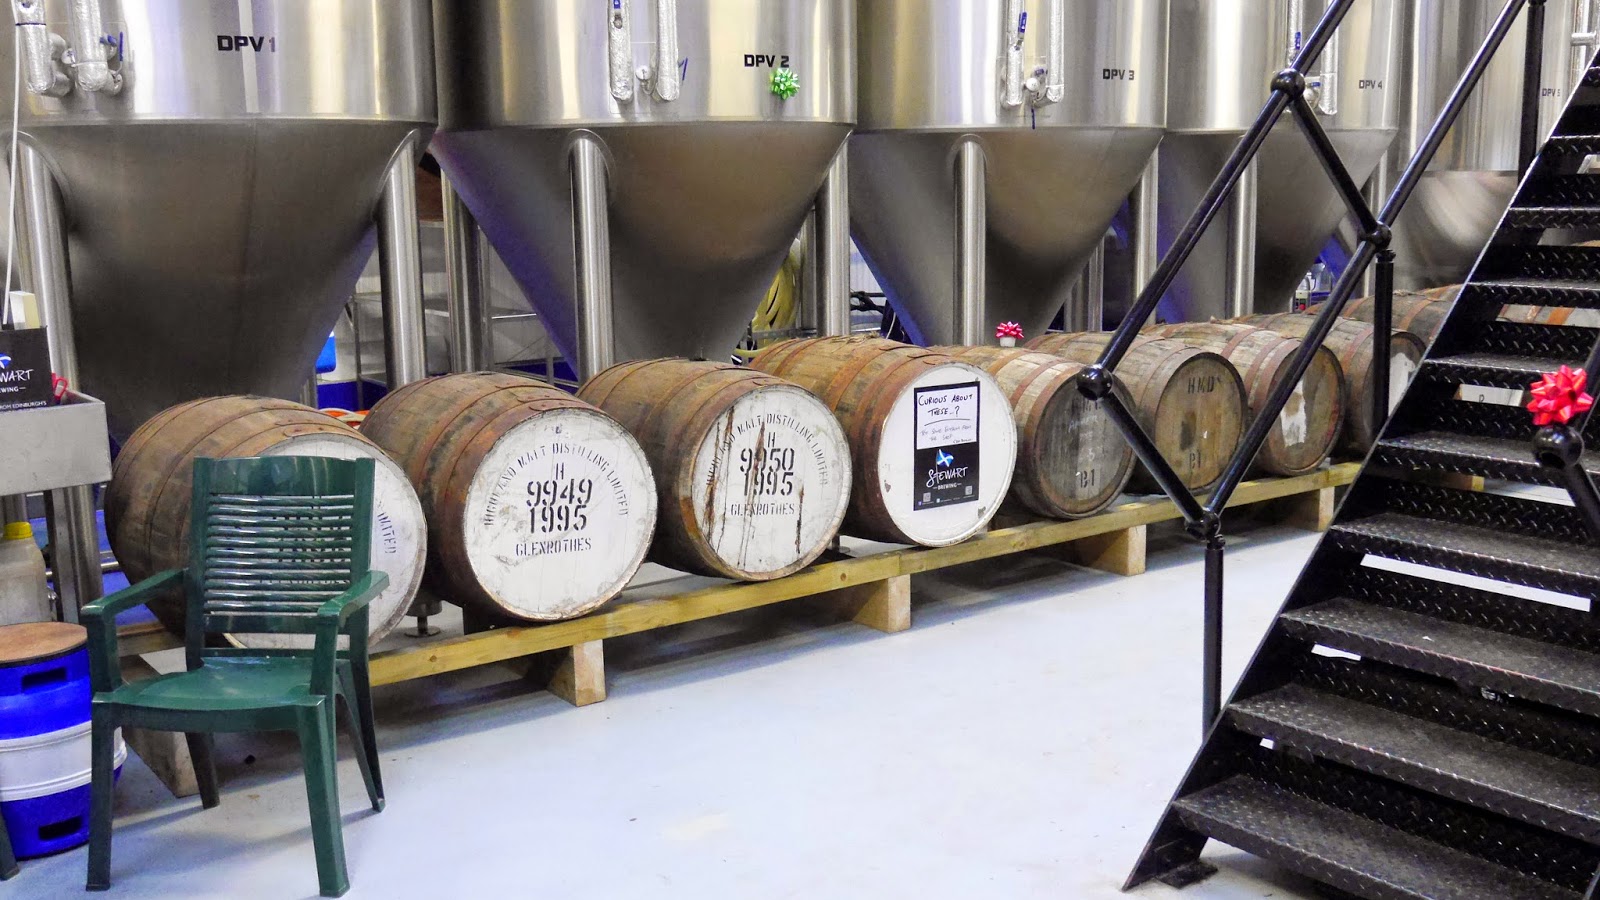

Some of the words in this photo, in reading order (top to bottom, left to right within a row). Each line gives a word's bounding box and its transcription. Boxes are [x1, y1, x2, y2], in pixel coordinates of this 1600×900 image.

[217, 35, 265, 52] DPV
[268, 36, 276, 53] 1
[744, 54, 775, 68] DPV
[780, 55, 790, 68] 2
[1102, 68, 1126, 80] DPV
[1128, 69, 1135, 81] 3
[1358, 79, 1376, 90] DPV
[1377, 79, 1383, 90] 4
[1541, 87, 1556, 97] DPV
[918, 394, 948, 406] CURIOUS
[951, 393, 973, 403] ABOUT
[737, 414, 761, 435] MALT
[766, 412, 815, 444] DISTILLING
[810, 442, 828, 485] LIMITED
[767, 431, 776, 449] H
[517, 445, 546, 469] MALT
[552, 442, 610, 472] DISTILLING
[607, 470, 629, 516] LIMITED
[555, 462, 565, 480] H
[926, 466, 969, 488] STEWART
[526, 478, 593, 507] 9949
[529, 504, 588, 534] 1995
[515, 537, 592, 557] GLENROTHES
